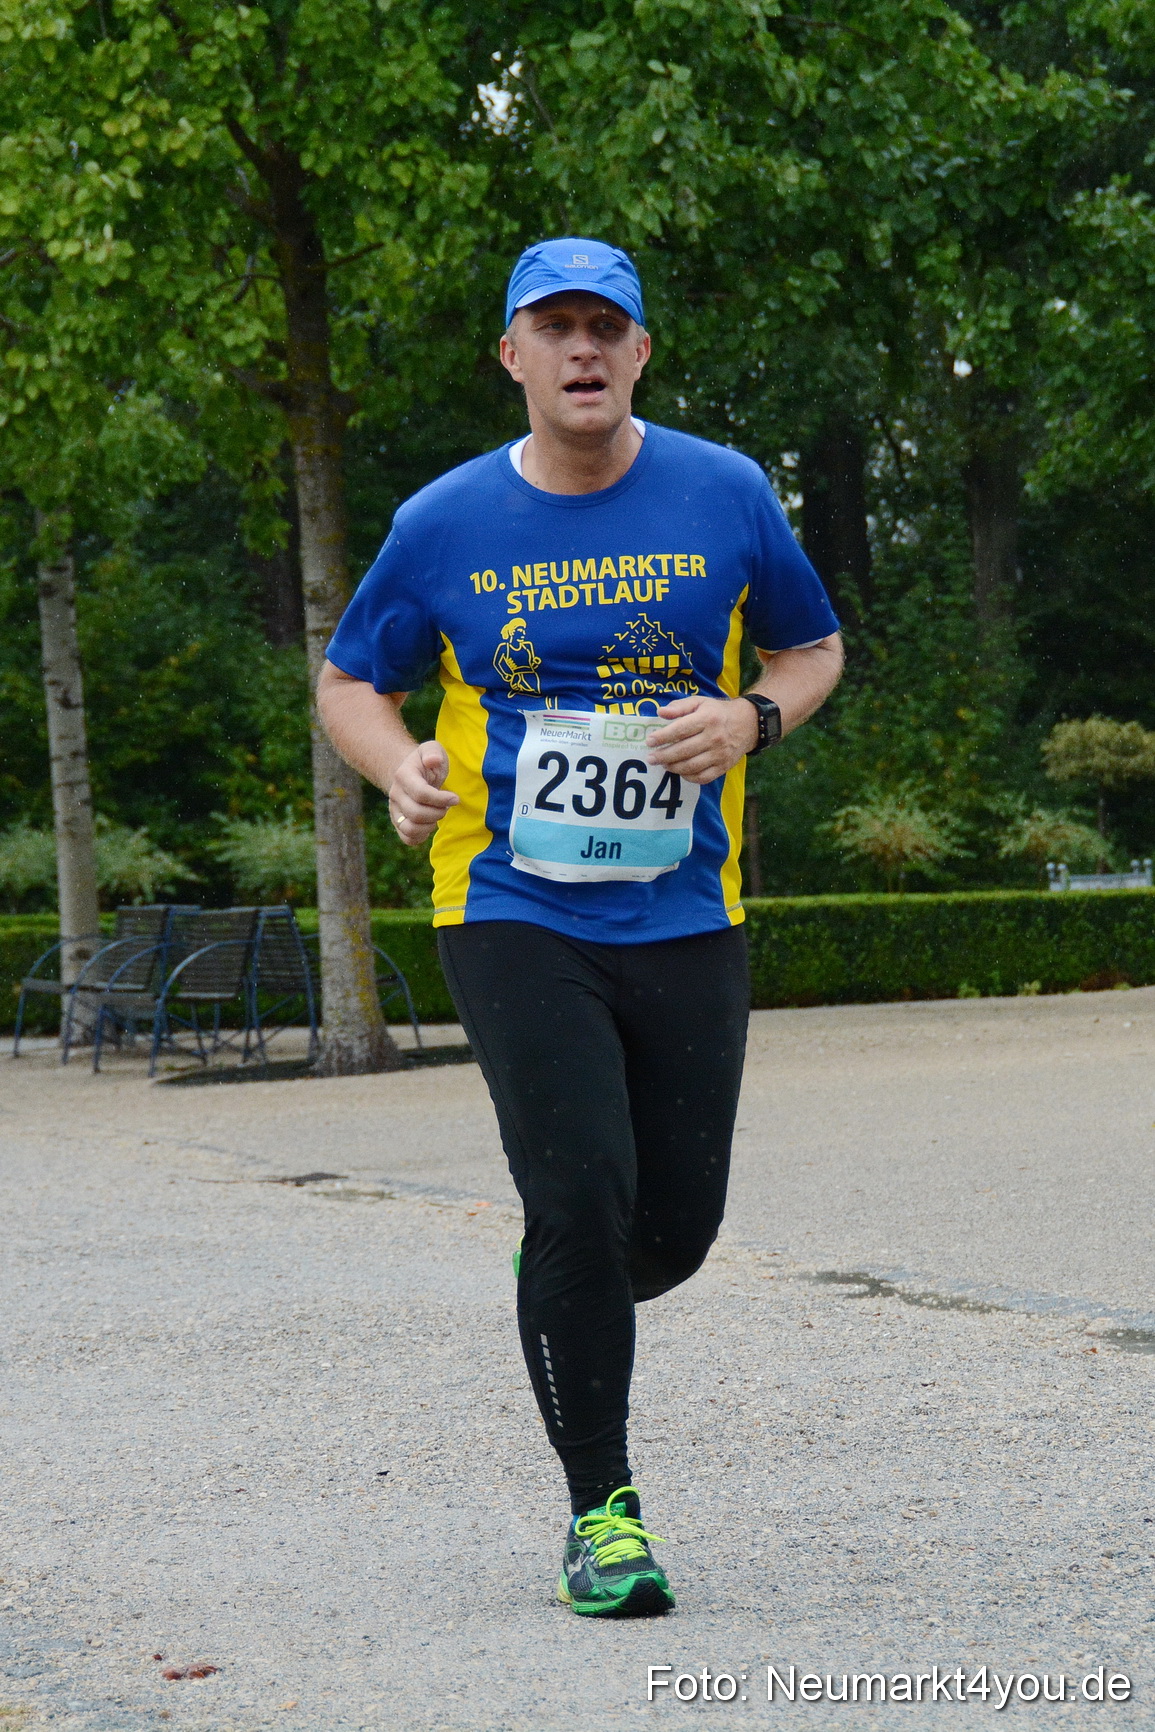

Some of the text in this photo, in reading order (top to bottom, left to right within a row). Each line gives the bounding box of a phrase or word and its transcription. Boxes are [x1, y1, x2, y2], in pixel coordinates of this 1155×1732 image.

[469, 553, 707, 594] 10. NEUMARKTER
[506, 578, 670, 614] STADTLAUF
[540, 728, 592, 741] NeuerMarkt
[535, 750, 683, 820] 2364
[521, 804, 529, 815] D
[580, 835, 622, 859] Jan
